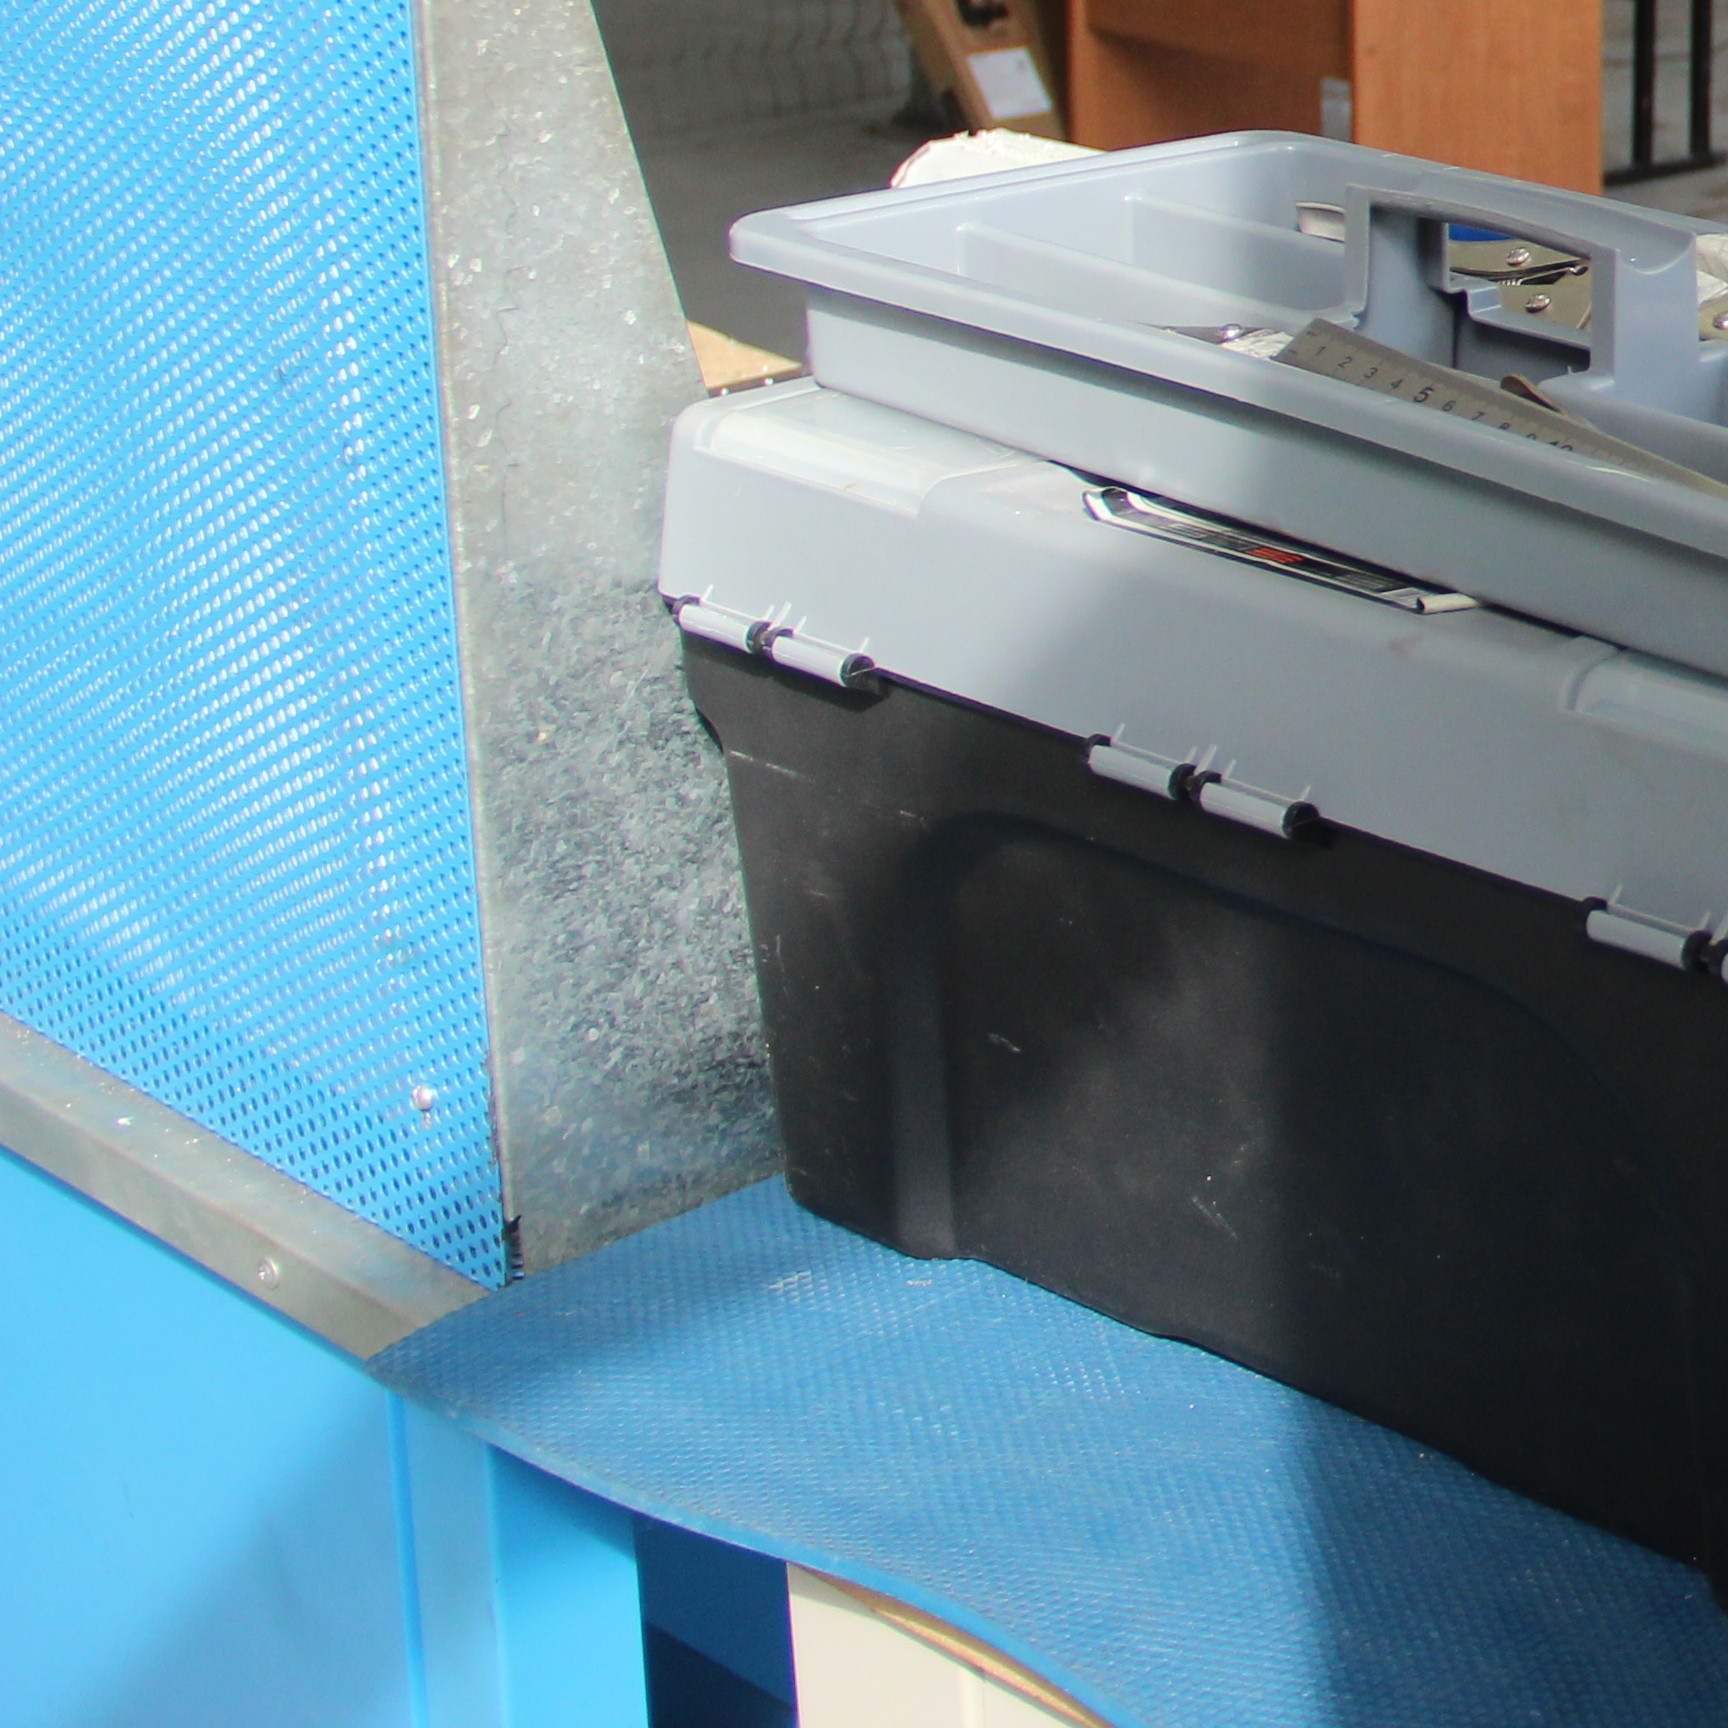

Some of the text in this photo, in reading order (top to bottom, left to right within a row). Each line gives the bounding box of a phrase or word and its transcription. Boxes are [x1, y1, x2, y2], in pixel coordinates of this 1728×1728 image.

[1315, 346, 1326, 357] 1
[1337, 356, 1353, 369] 2
[1363, 367, 1378, 379] 3
[1391, 379, 1403, 390] 4
[1414, 387, 1435, 403] 5
[1442, 400, 1457, 412] 6
